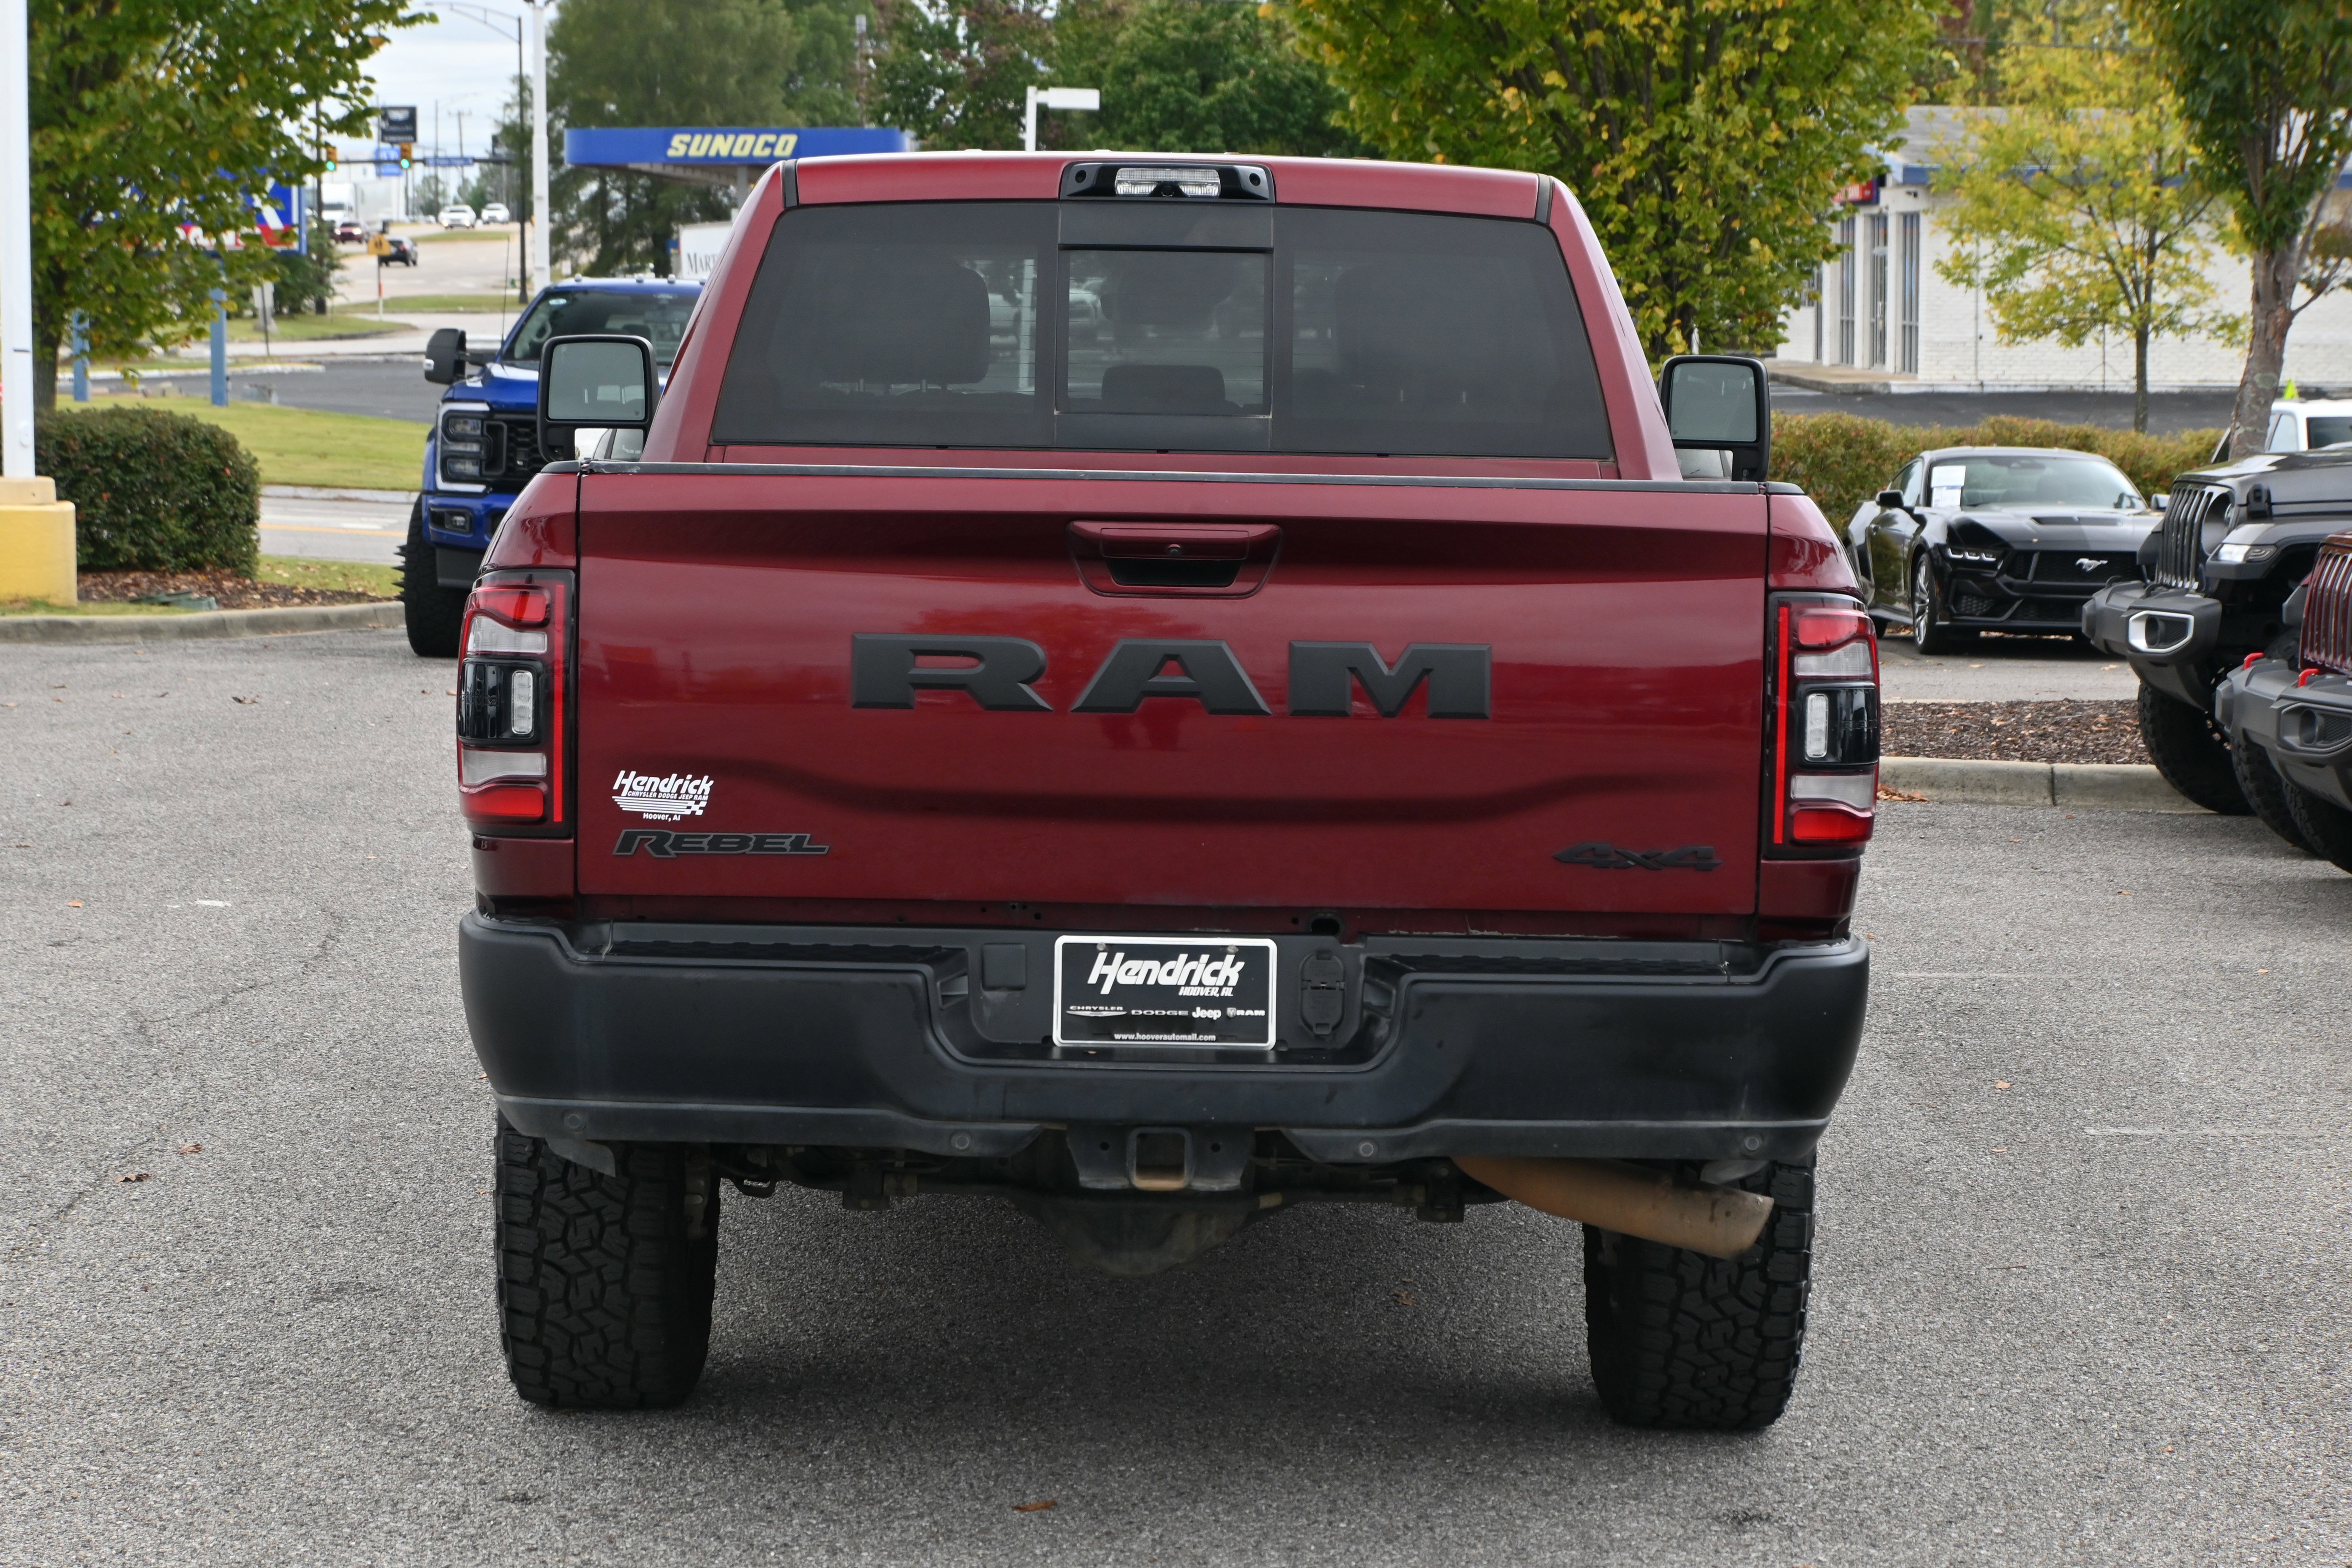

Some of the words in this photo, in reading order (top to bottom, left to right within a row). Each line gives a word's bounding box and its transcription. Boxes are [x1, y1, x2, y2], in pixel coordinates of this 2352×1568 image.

[667, 133, 798, 157] SUNOCO
[852, 633, 1492, 719] RAM
[613, 770, 714, 796] Hendrick
[643, 813, 671, 822] Hoover,
[612, 829, 830, 858] REBEL
[1087, 952, 1245, 995] Hendrick
[1178, 986, 1220, 997] HOOVER,
[1219, 987, 1233, 997] AL
[1192, 1007, 1222, 1021] Jeep
[1113, 1032, 1216, 1042] www.hooverautomall.com
